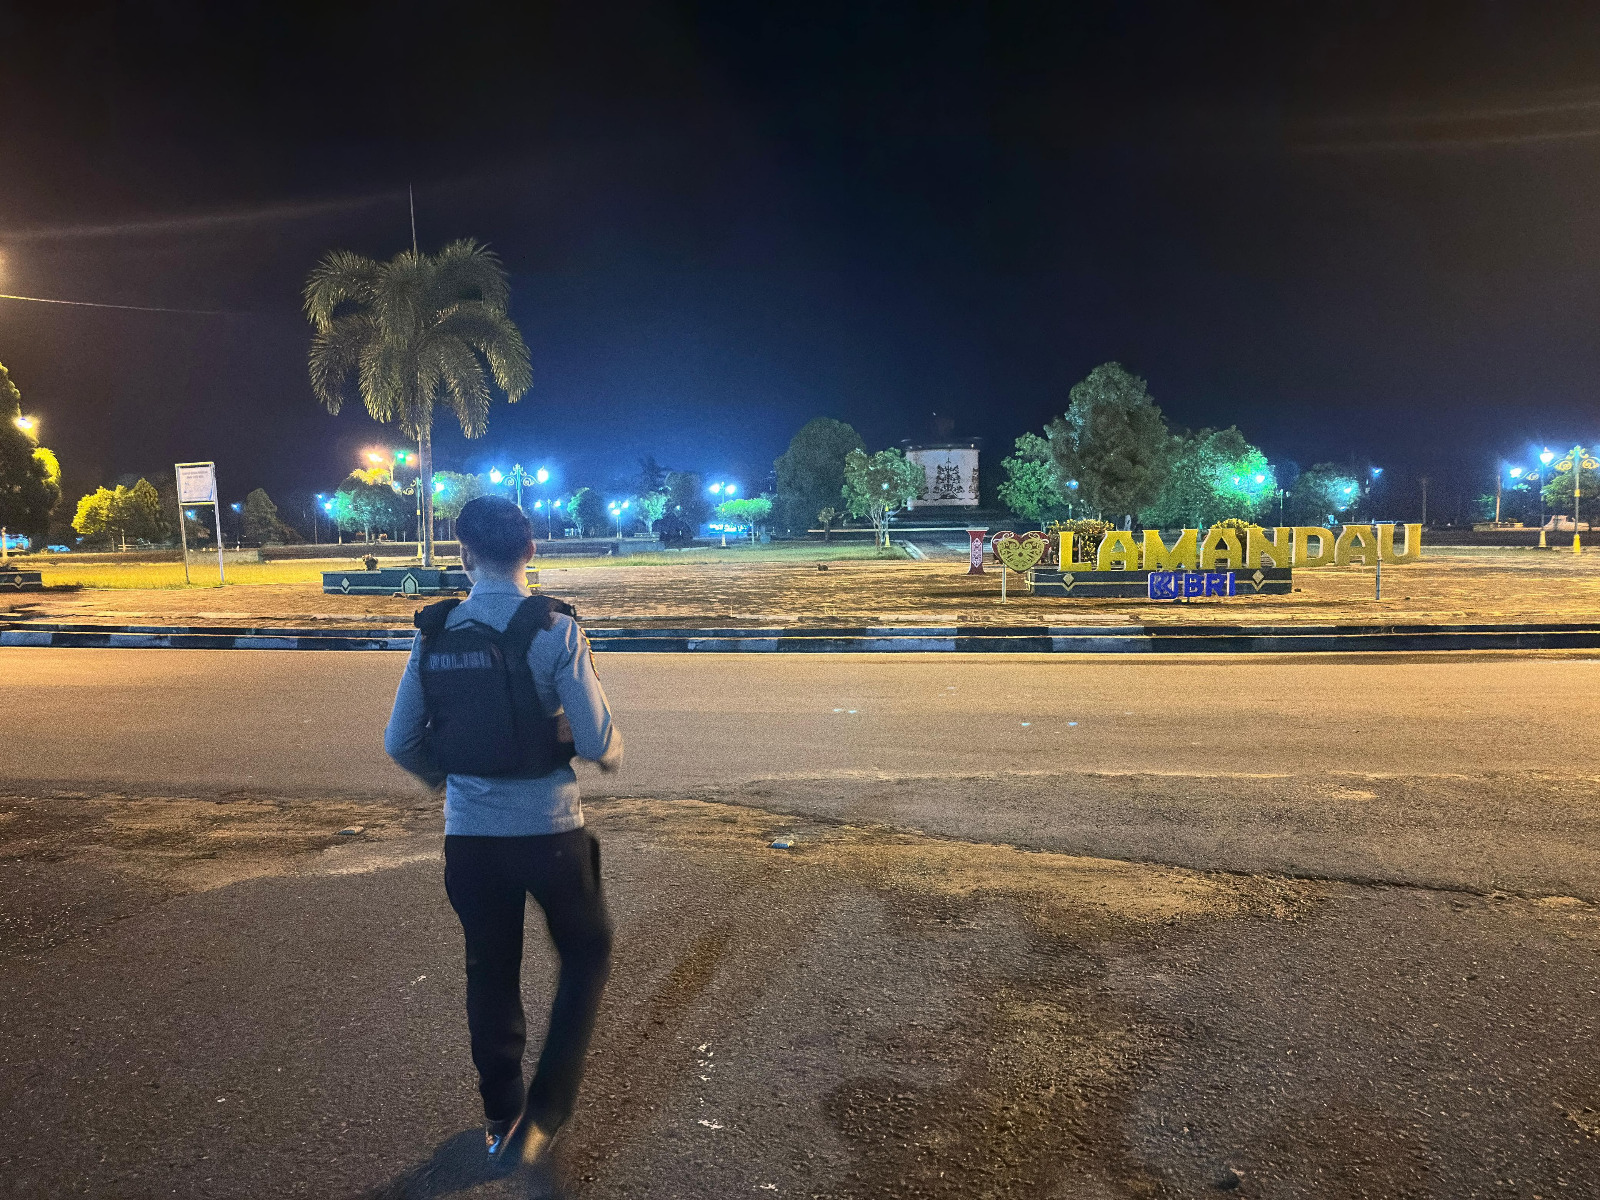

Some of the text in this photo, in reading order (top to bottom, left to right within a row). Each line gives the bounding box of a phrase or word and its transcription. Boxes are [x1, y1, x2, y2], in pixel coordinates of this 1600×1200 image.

[966, 523, 1423, 575] I LAMANDAU
[1182, 571, 1236, 597] BRI
